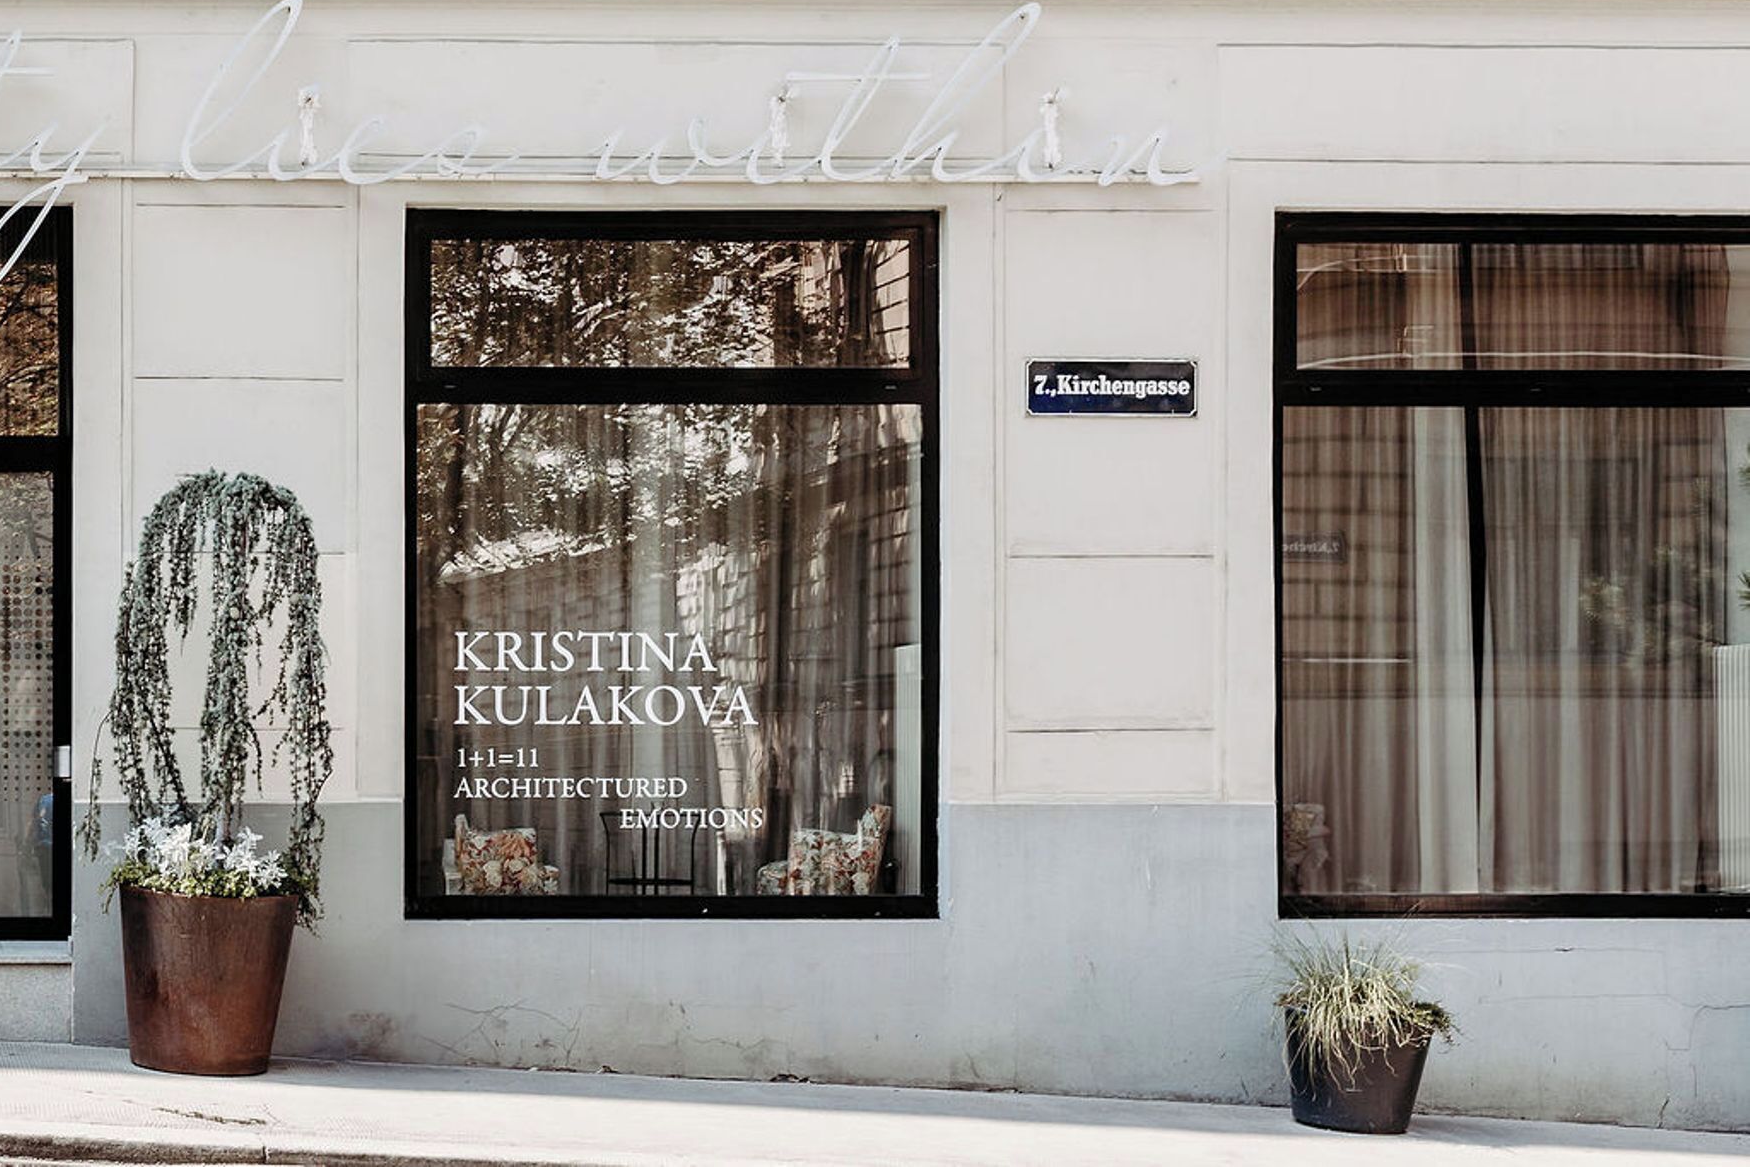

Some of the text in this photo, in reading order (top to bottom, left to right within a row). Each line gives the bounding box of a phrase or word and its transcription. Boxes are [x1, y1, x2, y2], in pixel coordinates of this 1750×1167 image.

[591, 1, 1200, 187] within
[454, 630, 717, 672] KRISTINA
[454, 684, 759, 726] KULAKOVA
[457, 748, 539, 768] 1+1=11
[454, 777, 688, 799] ARCHITECTURED
[620, 808, 763, 829] EMOTIONS
